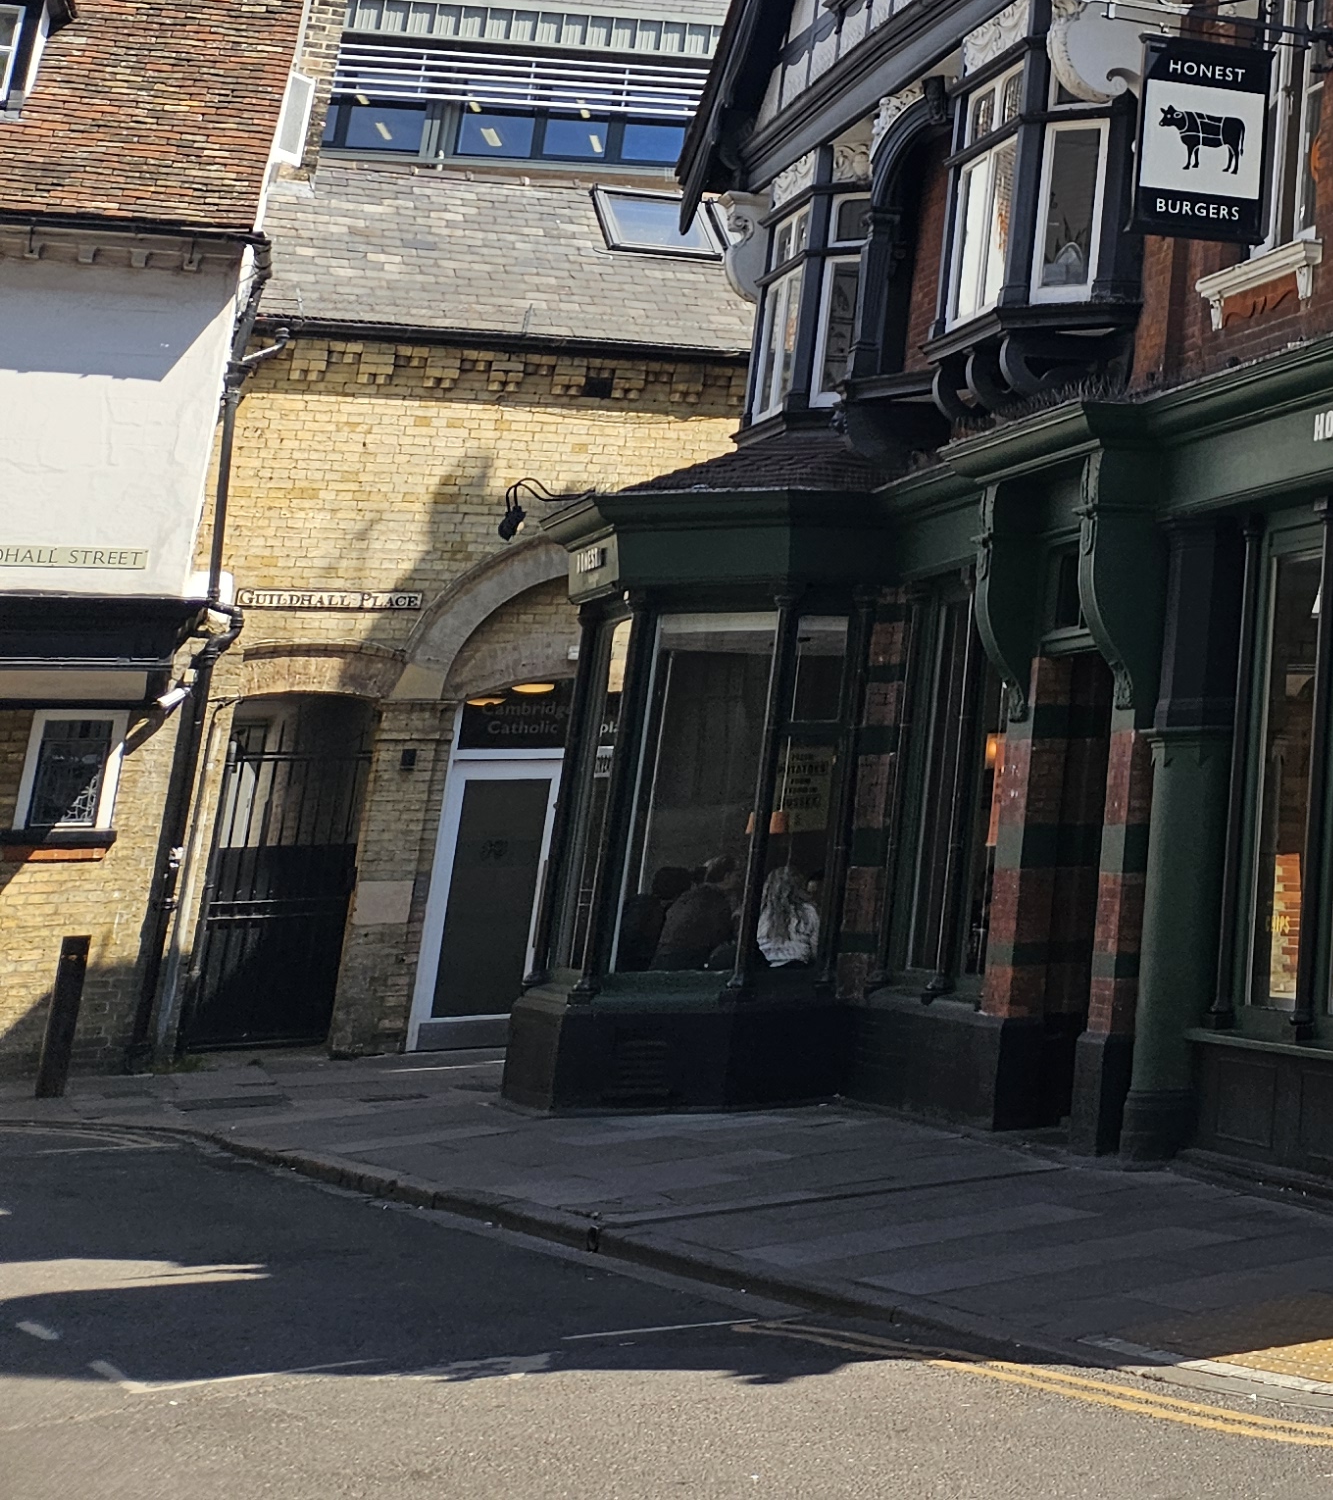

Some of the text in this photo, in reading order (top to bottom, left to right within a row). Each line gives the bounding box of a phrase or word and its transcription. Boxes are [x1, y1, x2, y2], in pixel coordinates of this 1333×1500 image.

[1169, 59, 1246, 83] HONEST
[1156, 198, 1240, 221] BURGERS
[0, 548, 144, 566] HALL STREET
[487, 720, 558, 735] Catholic
